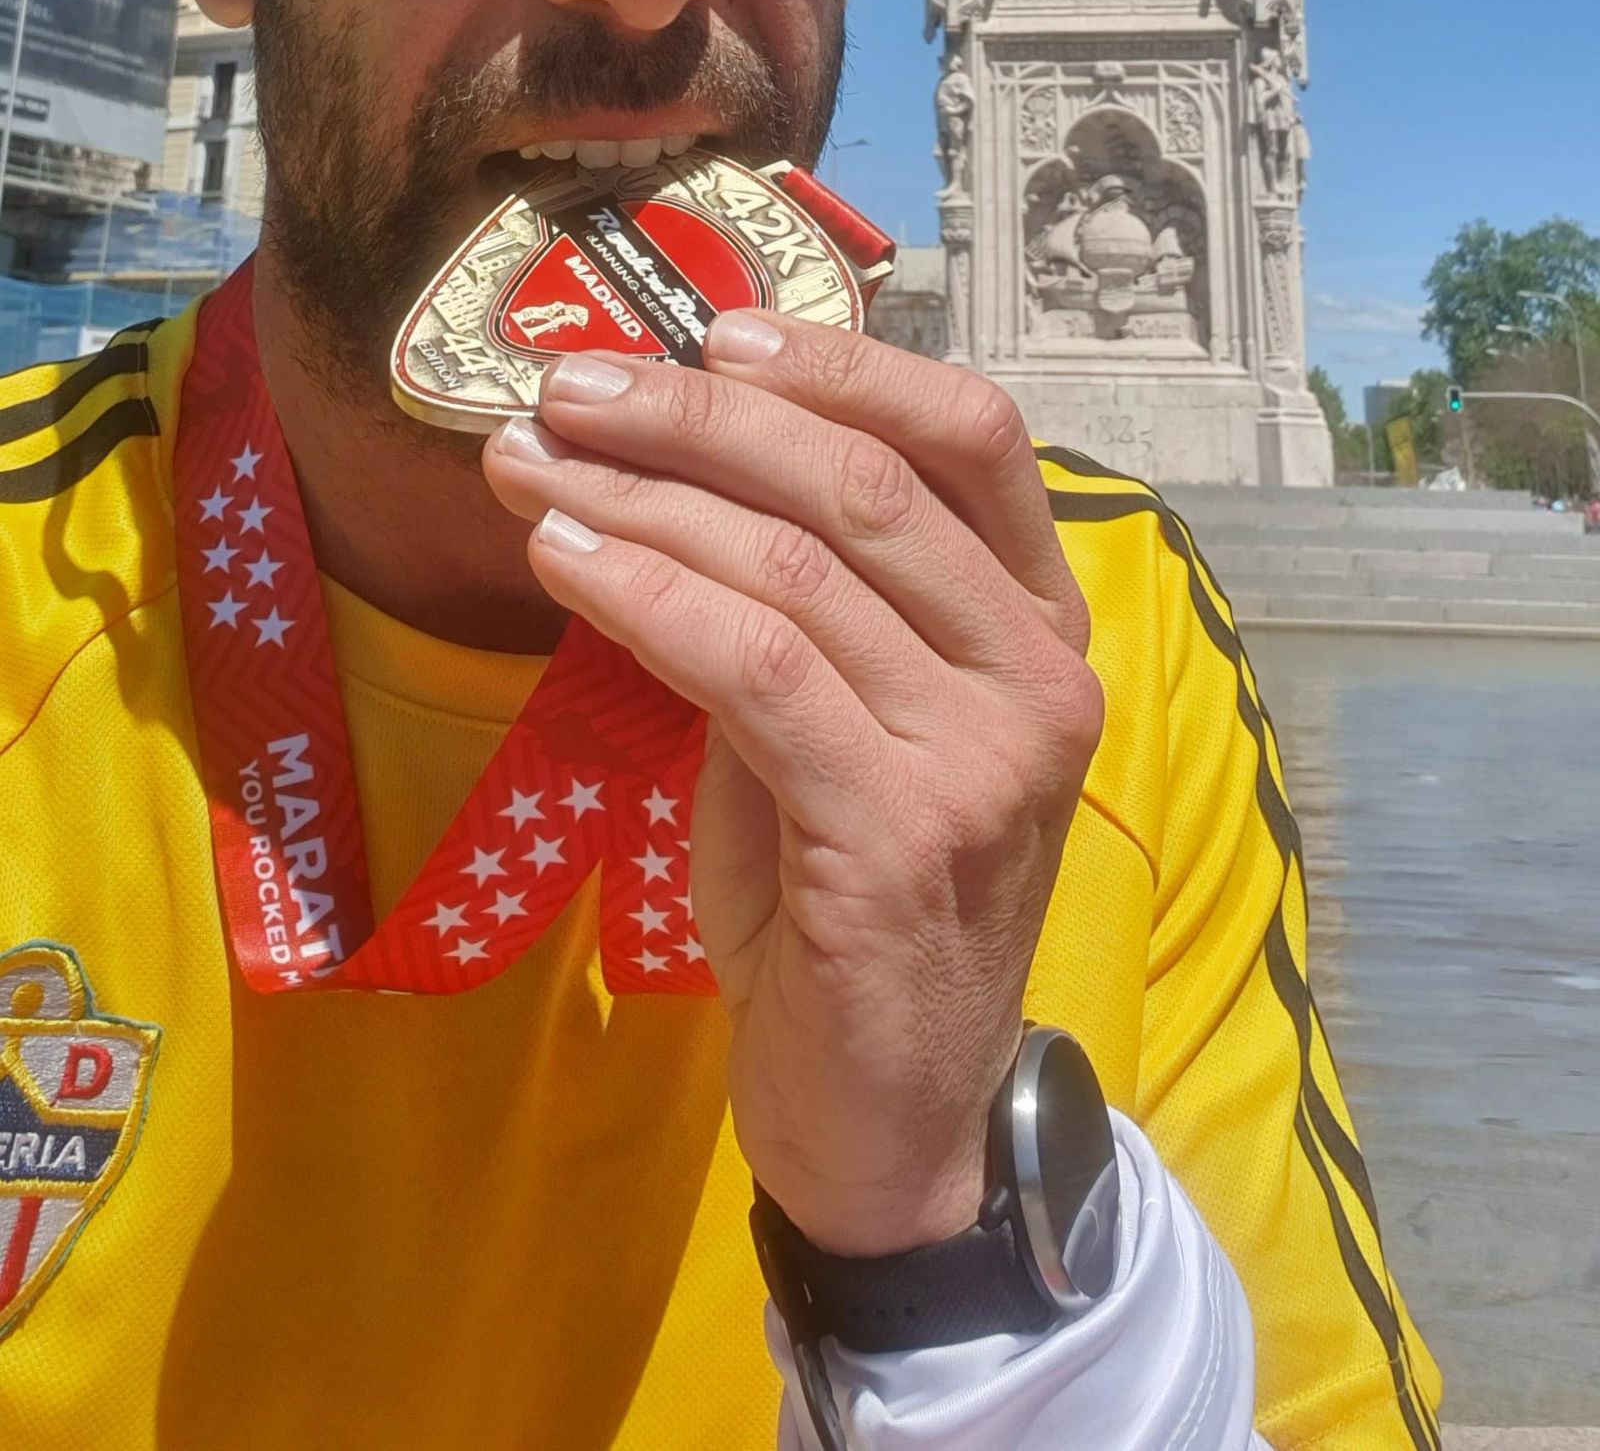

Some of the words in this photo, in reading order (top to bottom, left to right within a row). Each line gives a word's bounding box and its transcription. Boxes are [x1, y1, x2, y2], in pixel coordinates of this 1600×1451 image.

[719, 189, 829, 278] 42K
[415, 339, 462, 389] EDITION
[239, 759, 268, 826] YOU
[266, 732, 345, 978] MARAT
[249, 834, 292, 965] ROCKED
[58, 1044, 114, 1102] D
